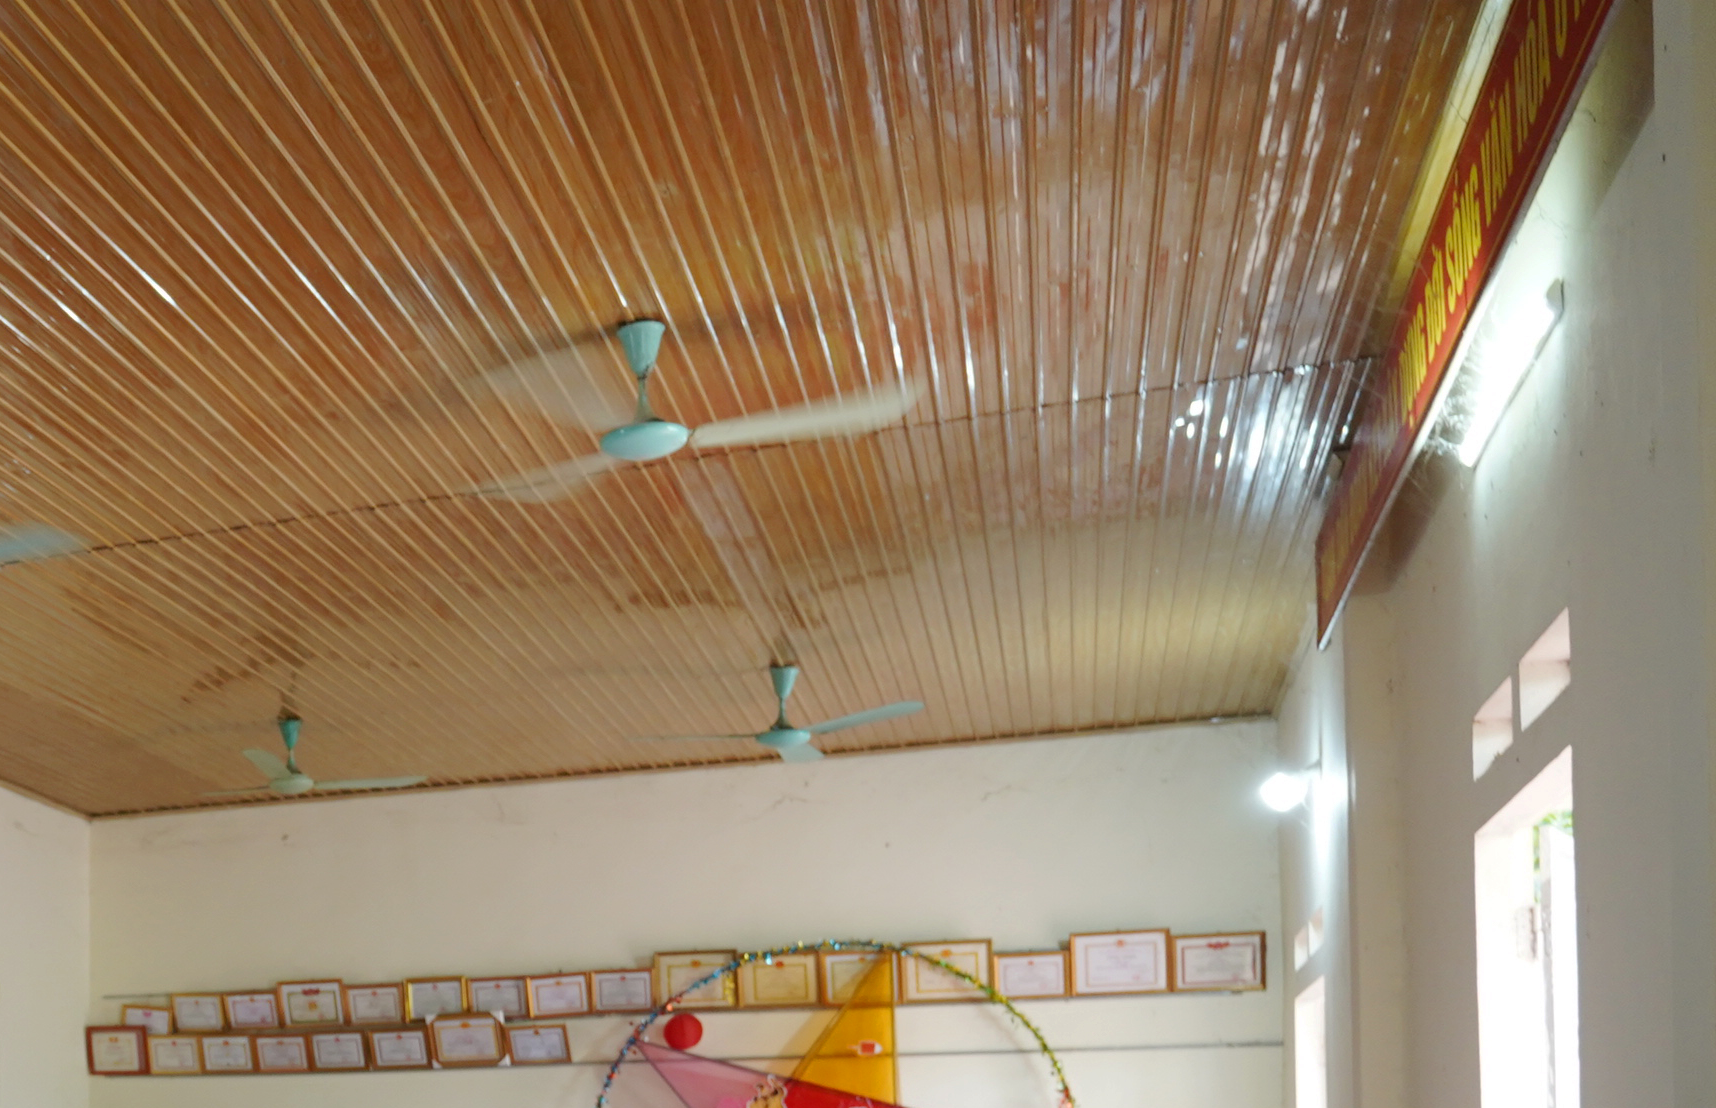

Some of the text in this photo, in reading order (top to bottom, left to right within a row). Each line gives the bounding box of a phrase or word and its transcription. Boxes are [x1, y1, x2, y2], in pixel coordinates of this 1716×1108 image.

[1398, 301, 1427, 430] DỰNG
[1425, 242, 1448, 364] ĐỜI
[1445, 163, 1482, 315] SỐNG
[1481, 79, 1513, 228] VĂN
